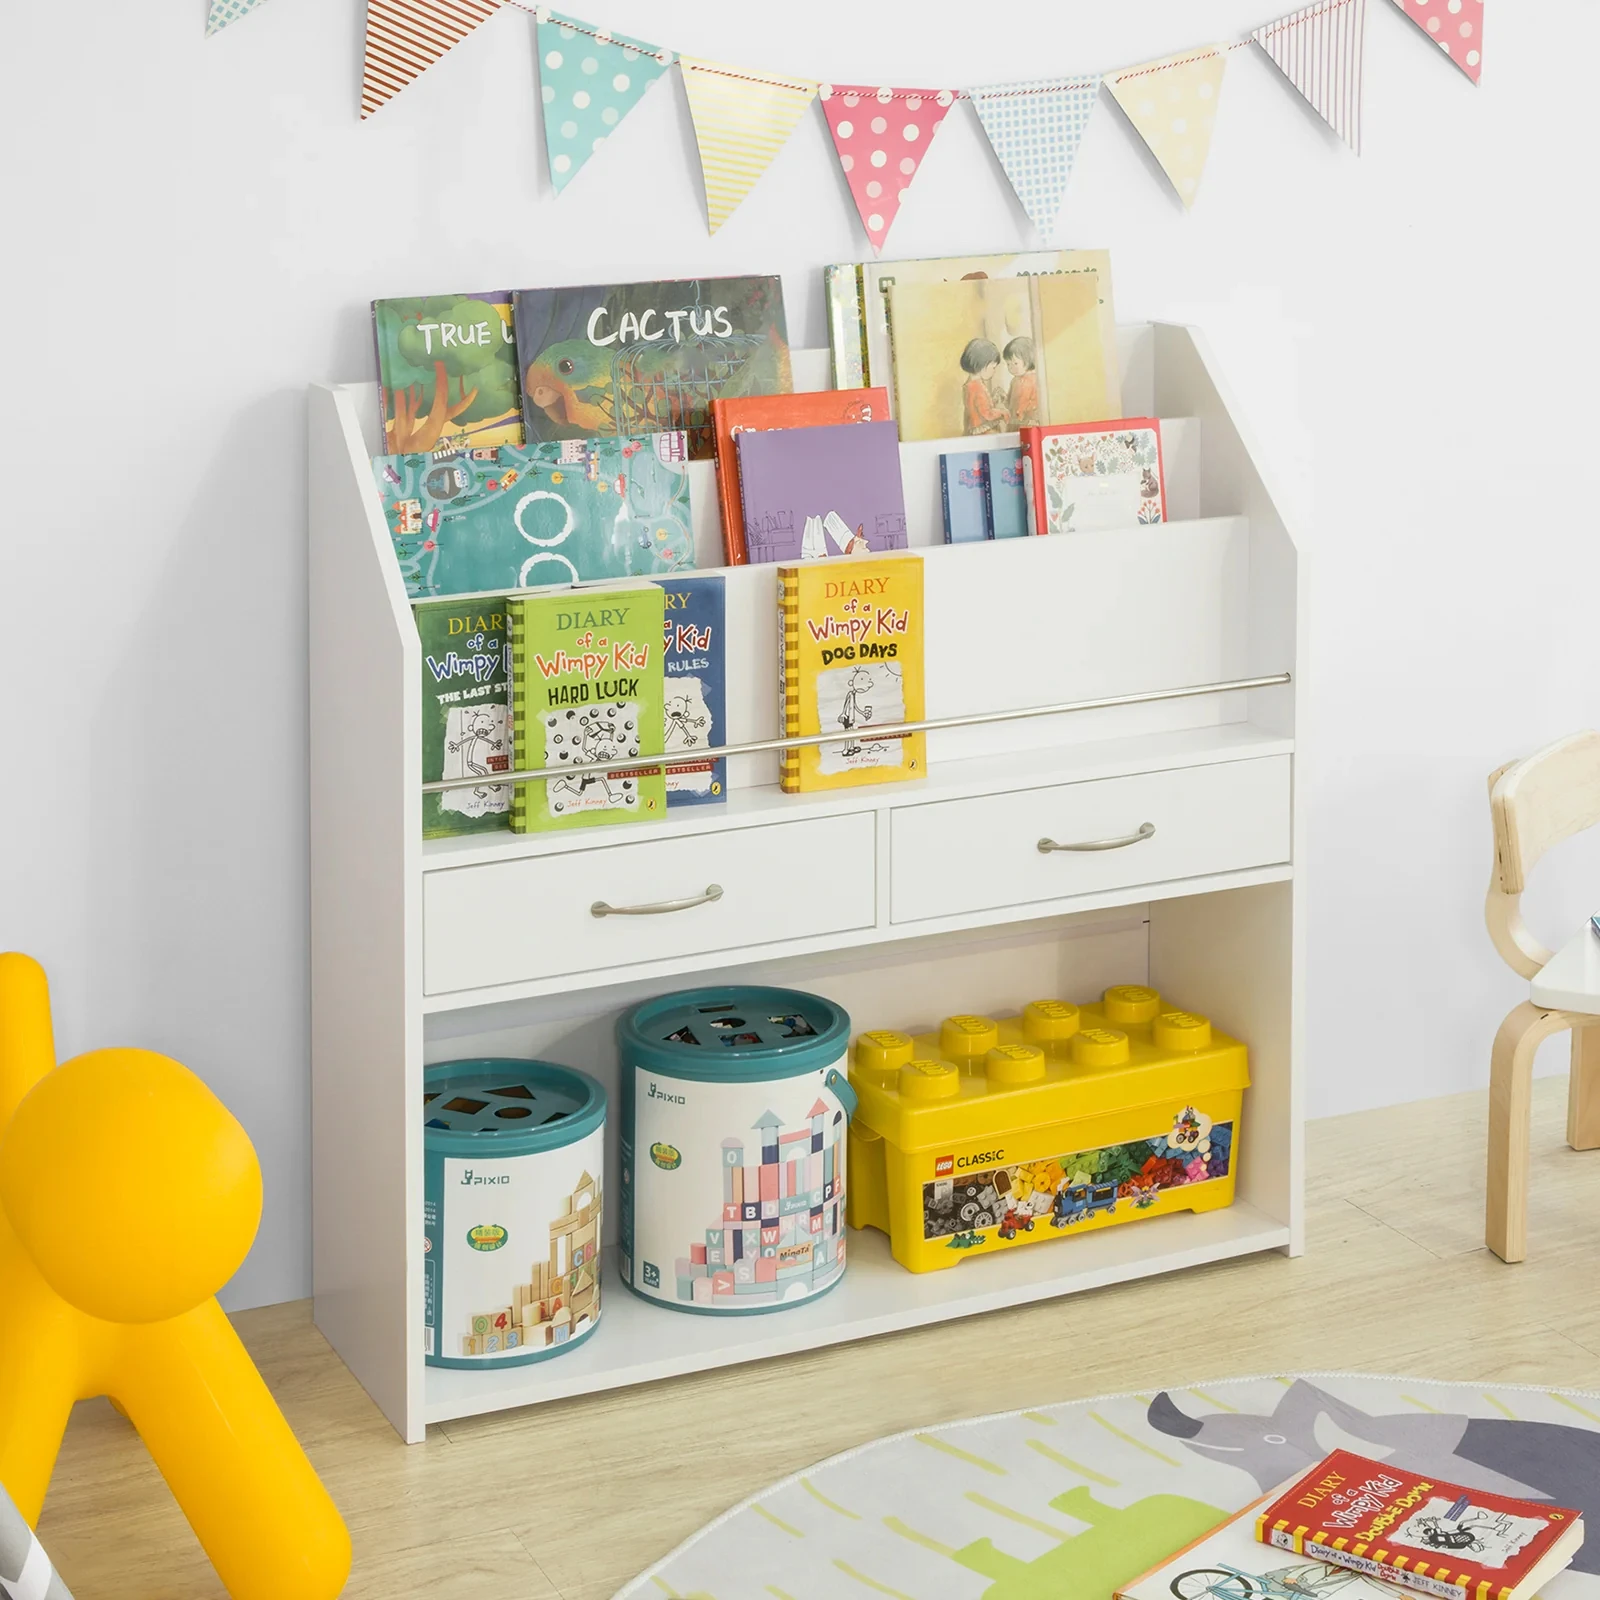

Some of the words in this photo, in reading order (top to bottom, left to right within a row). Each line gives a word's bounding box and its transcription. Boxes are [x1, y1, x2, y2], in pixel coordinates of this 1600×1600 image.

[586, 305, 733, 347] CACTUS
[416, 320, 491, 355] TRUE
[825, 576, 890, 599] DIARY
[843, 598, 858, 614] of
[862, 603, 872, 613] a
[447, 613, 505, 635] DIAR
[556, 607, 631, 631] DIARY
[807, 615, 873, 643] Wimpy
[876, 607, 909, 636] Kid
[466, 632, 485, 651] of
[487, 638, 499, 649] a
[576, 631, 593, 649] of
[597, 637, 608, 648] a
[676, 623, 712, 653] Kid
[535, 650, 609, 681] Wimpy
[613, 640, 650, 673] Kid
[667, 657, 710, 672] RULES
[821, 646, 857, 666] DOG
[859, 643, 898, 659] DAYS
[425, 651, 500, 682] Wimpy
[435, 691, 461, 705] THE
[463, 684, 491, 700] LAST
[547, 683, 590, 706] HARD
[596, 678, 640, 700] LUCK
[609, 768, 660, 779] BESTSELLER
[936, 1160, 953, 1172] LEGO
[825, 1184, 832, 1199] P
[726, 1205, 738, 1219] T
[745, 1206, 757, 1219] B
[812, 1218, 821, 1232] M
[709, 1232, 720, 1245] V
[762, 1230, 777, 1244] W
[815, 1250, 824, 1267] A
[494, 1313, 508, 1329] 4
[468, 1338, 476, 1355] 1
[485, 1335, 500, 1353] 2
[505, 1331, 519, 1349] 3
[1297, 1470, 1348, 1509] DIARY
[1321, 1494, 1386, 1529] Wimpy
[1358, 1473, 1404, 1498] Kid
[1310, 1544, 1332, 1561] Diary
[1365, 1562, 1378, 1573] Kid
[1411, 1576, 1431, 1588] JEFF
[1431, 1583, 1464, 1598] KINNEY
